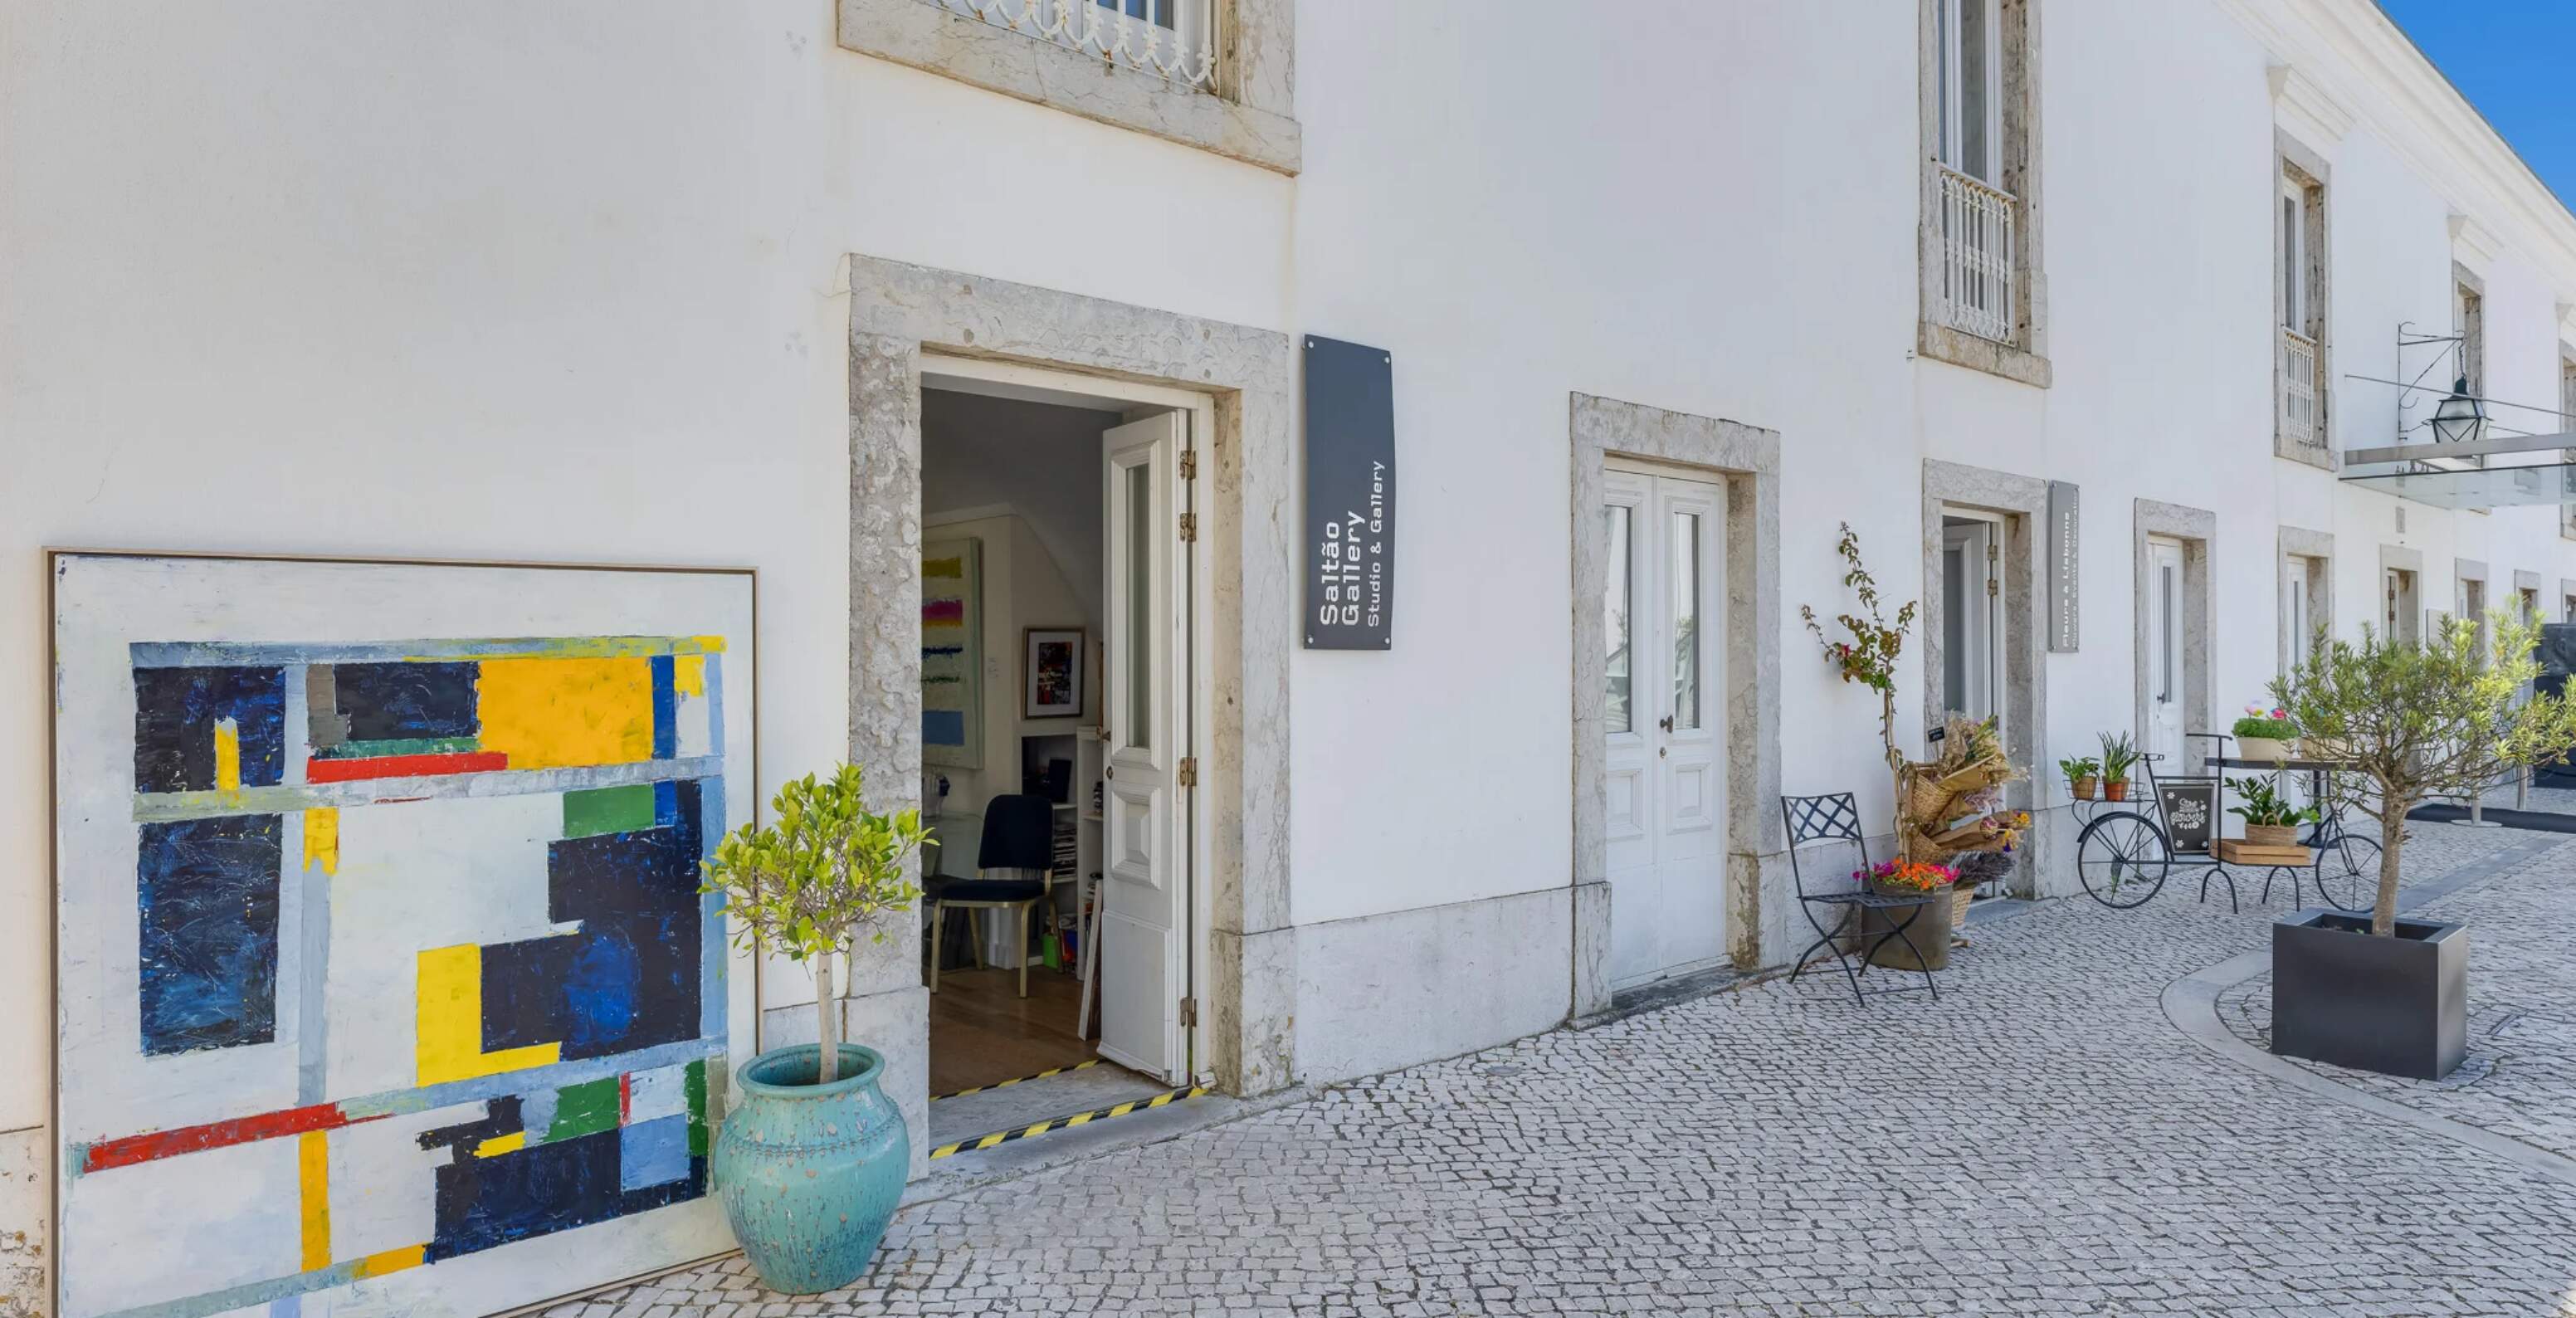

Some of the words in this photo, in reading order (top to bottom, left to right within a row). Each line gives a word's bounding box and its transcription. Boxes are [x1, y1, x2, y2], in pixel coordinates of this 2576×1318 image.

[1370, 461, 1385, 534] Gallery
[1320, 521, 1340, 626] Saltão
[1342, 510, 1366, 626] Gallery
[1370, 542, 1382, 554] &
[1368, 562, 1381, 627] Studio
